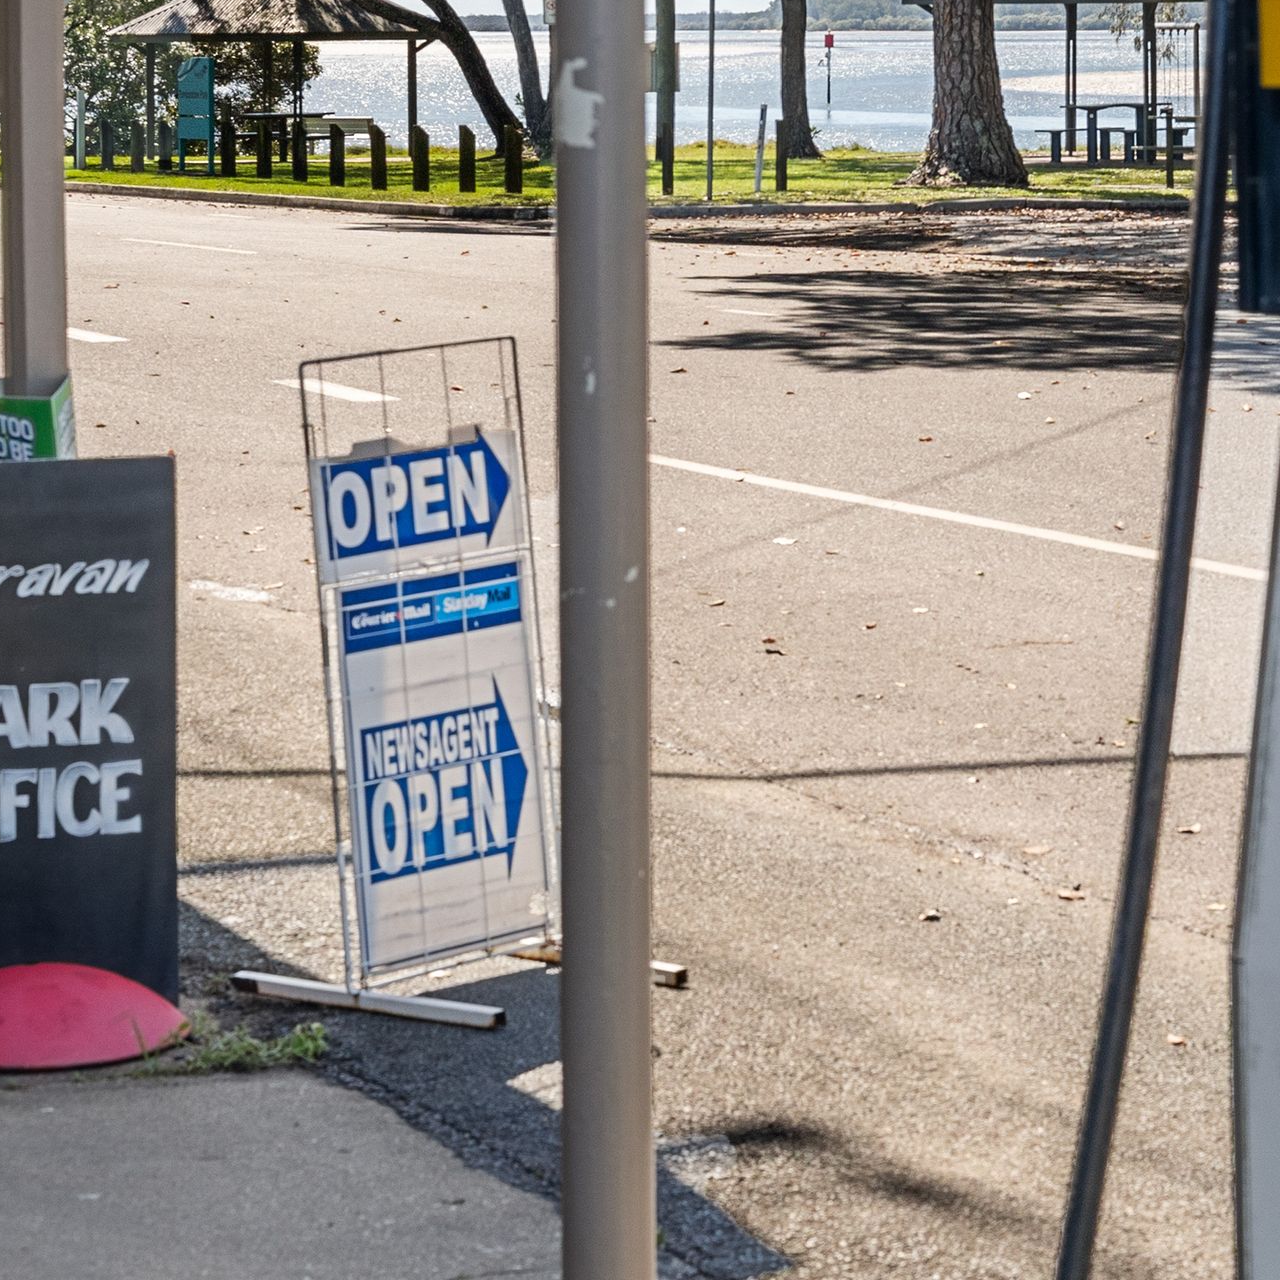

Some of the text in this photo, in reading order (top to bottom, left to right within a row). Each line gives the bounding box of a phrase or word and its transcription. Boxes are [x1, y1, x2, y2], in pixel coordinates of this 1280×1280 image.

[9, 439, 34, 461] BE
[328, 450, 490, 549] OPEN
[365, 707, 500, 780] NEWSAGENT
[371, 758, 509, 875] OPEN
